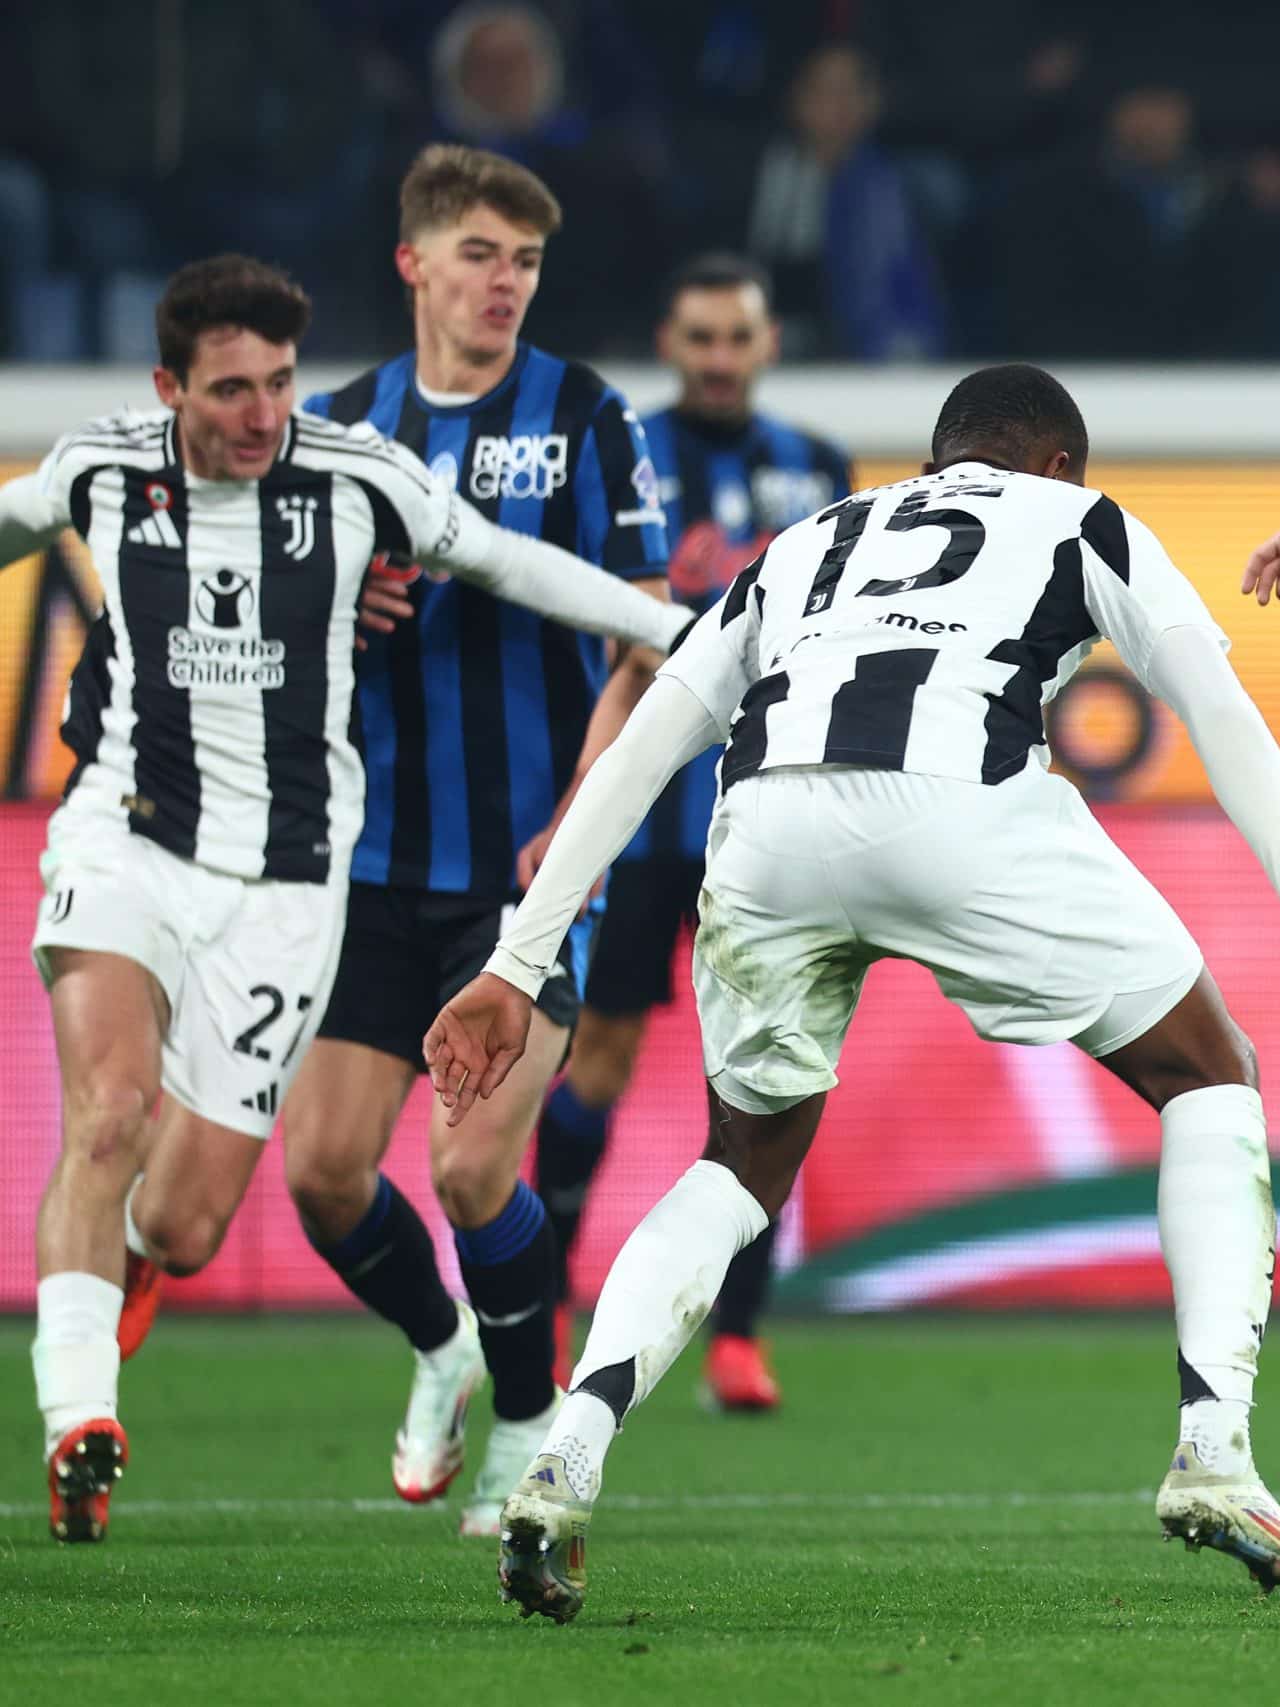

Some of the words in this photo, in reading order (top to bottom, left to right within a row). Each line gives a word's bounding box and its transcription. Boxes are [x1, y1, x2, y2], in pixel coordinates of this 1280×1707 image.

[472, 434, 569, 469] RADICI
[469, 466, 568, 500] GROUP
[802, 484, 1005, 618] 15
[171, 628, 232, 656] Save
[239, 637, 282, 659] the
[170, 660, 283, 686] Children
